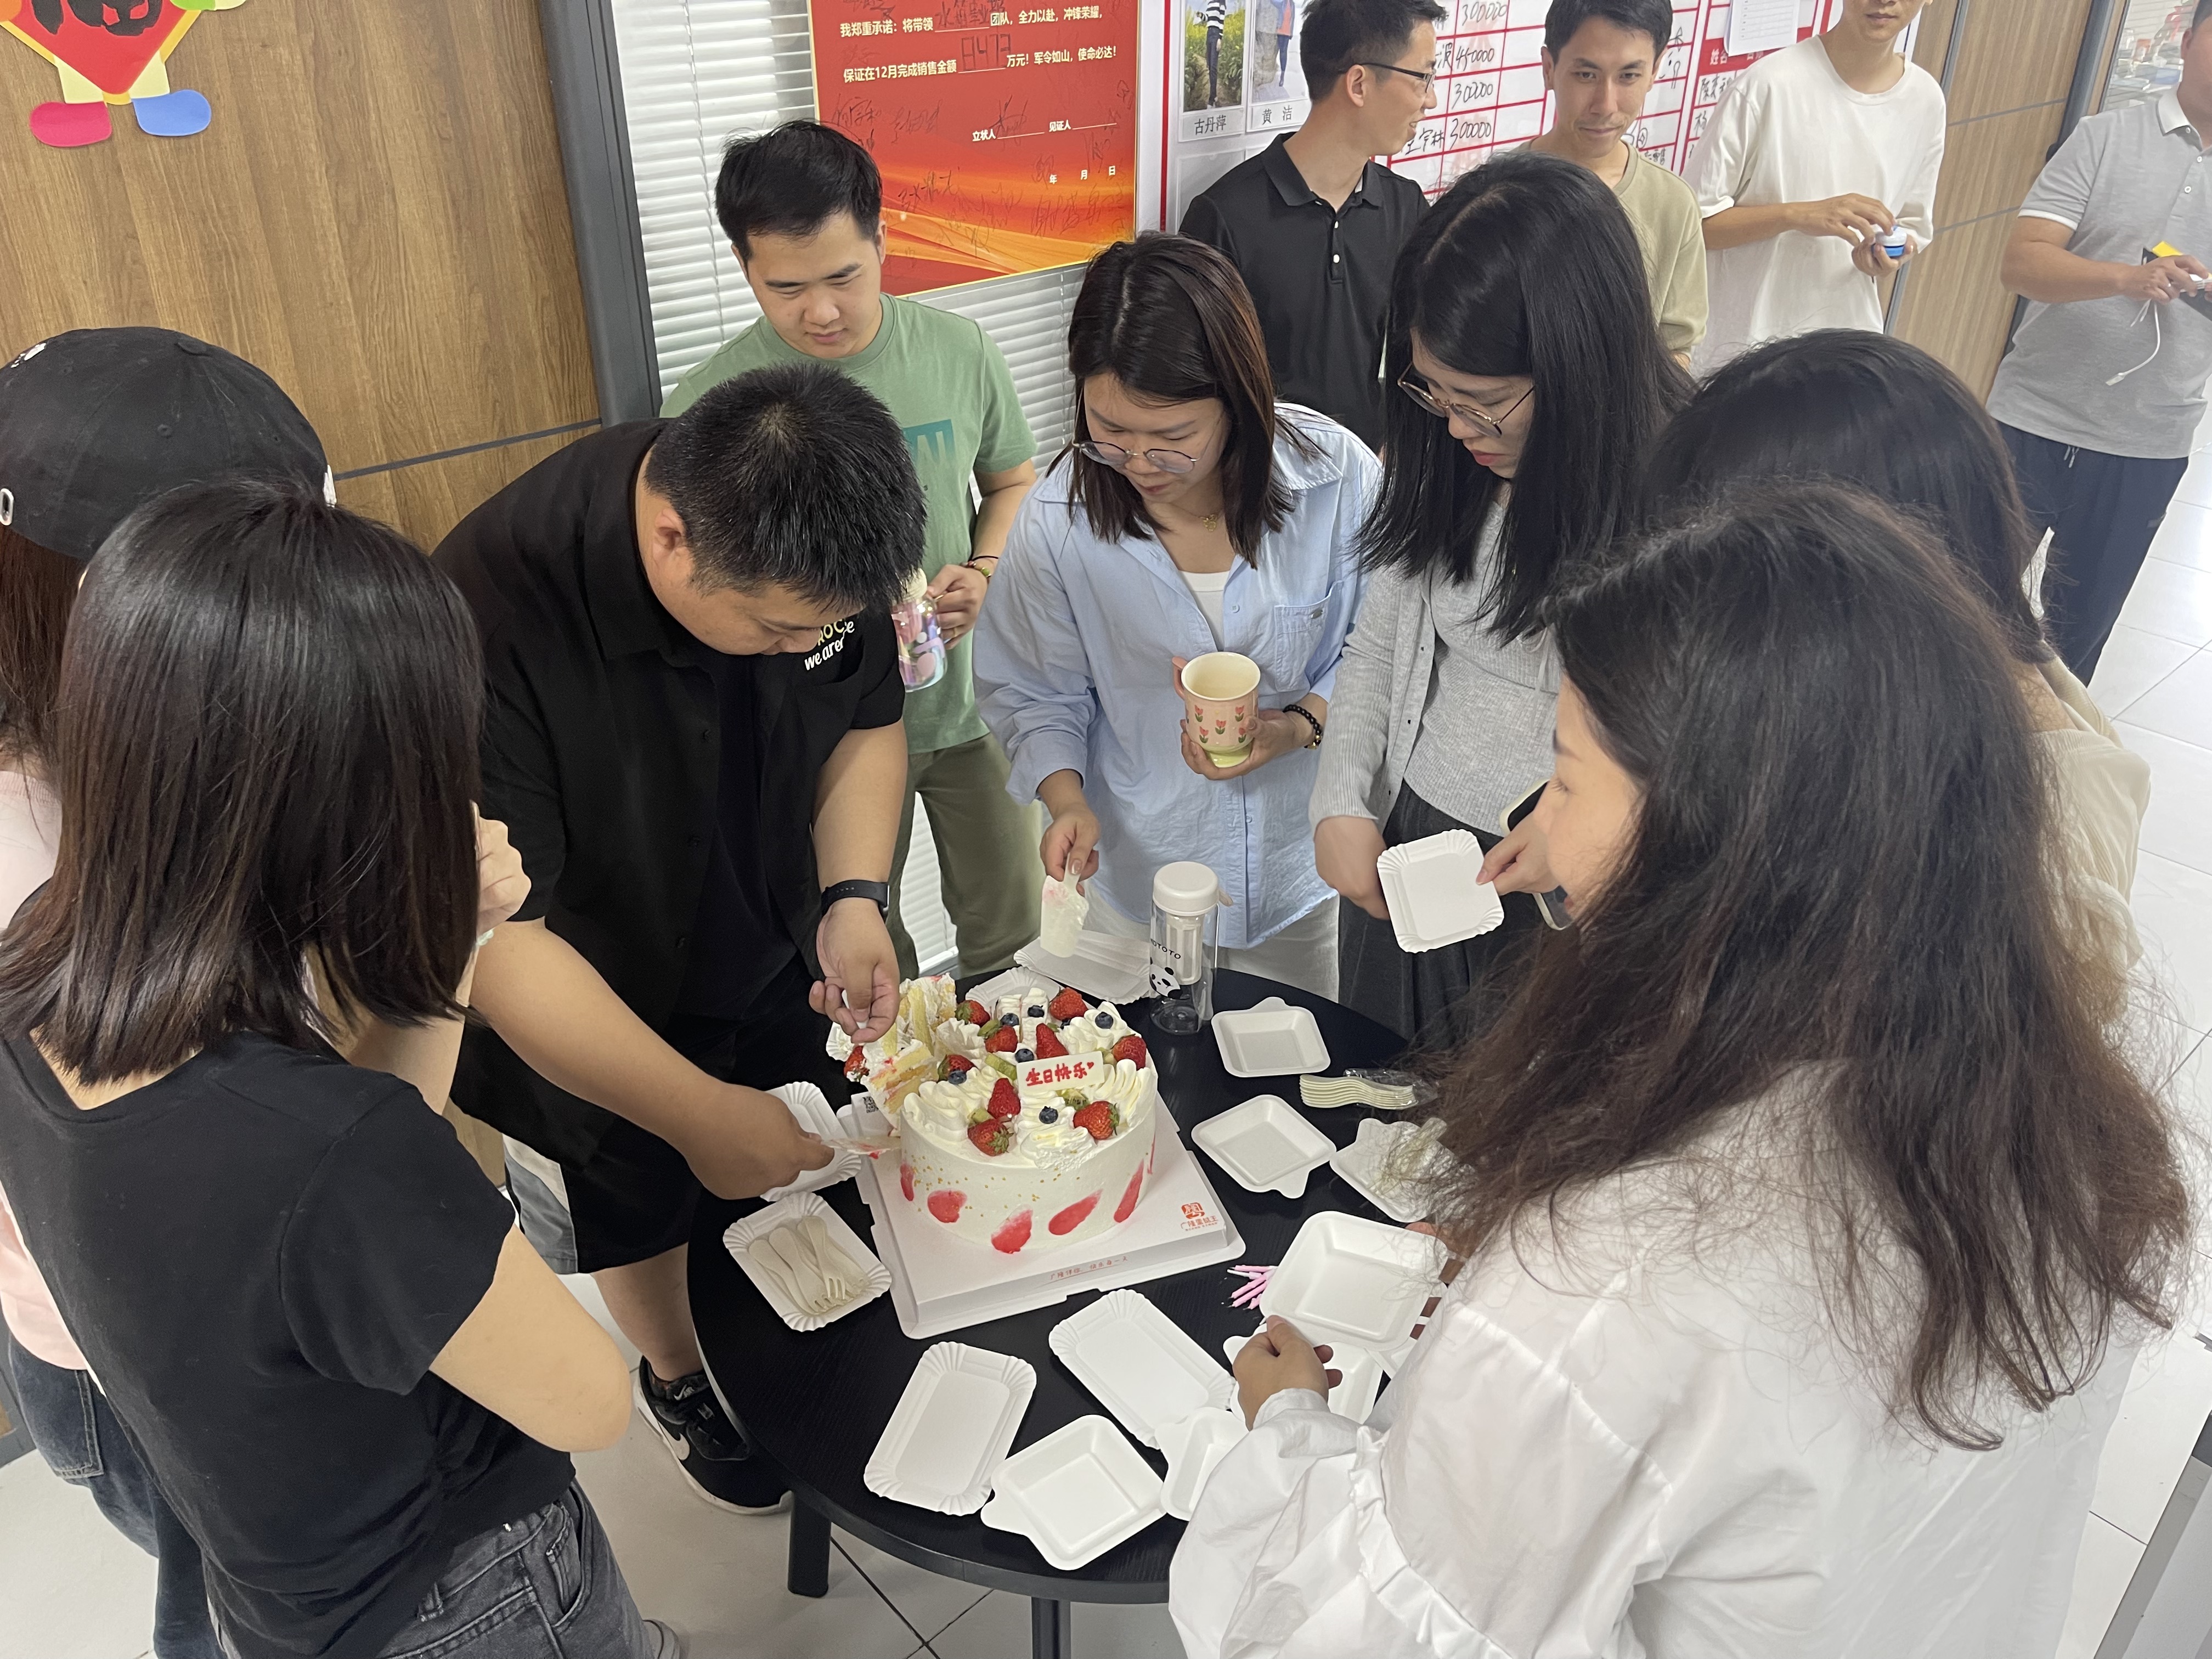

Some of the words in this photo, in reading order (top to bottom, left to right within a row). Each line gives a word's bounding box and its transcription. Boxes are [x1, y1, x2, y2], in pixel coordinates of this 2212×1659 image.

[1455, 46, 1495, 71] 450000
[843, 59, 957, 83] 保证在12月完成销售金额
[972, 128, 996, 142] 立状人
[1049, 120, 1071, 132] 见证人
[1194, 114, 1227, 136] 古丹萍
[1025, 1062, 1087, 1086] 生日快乐
